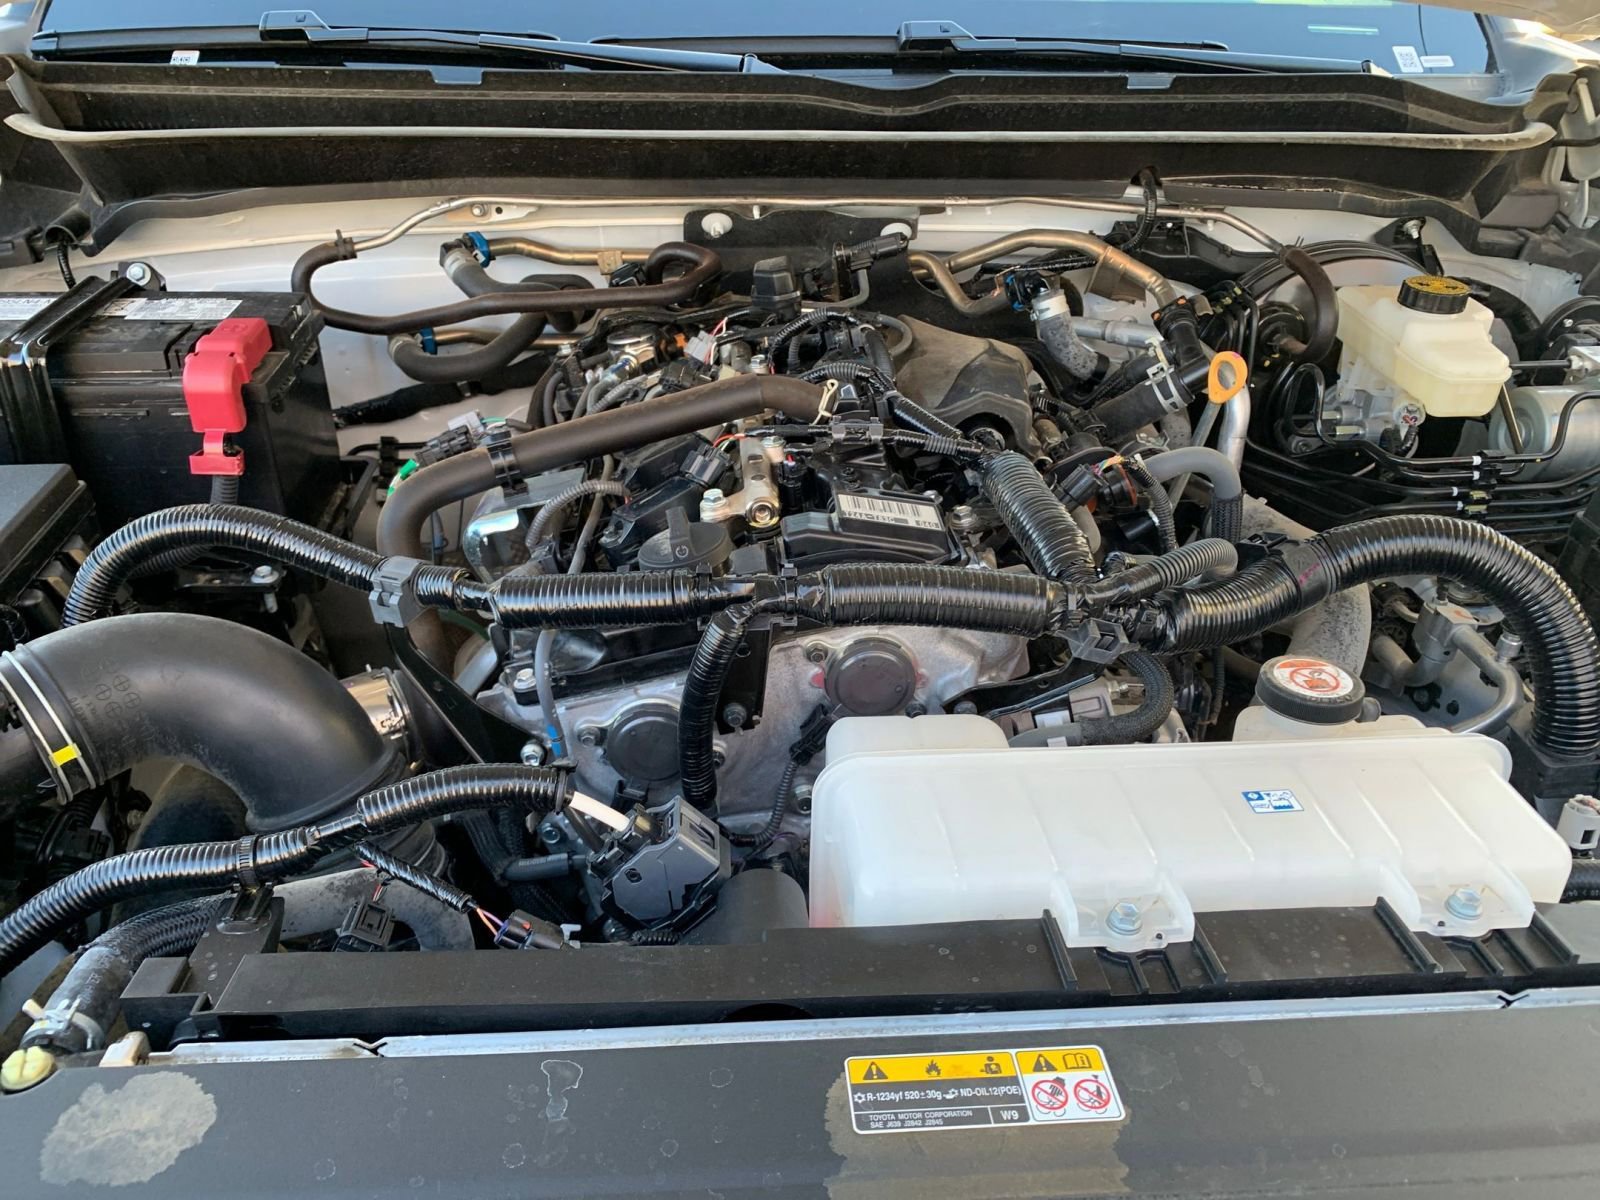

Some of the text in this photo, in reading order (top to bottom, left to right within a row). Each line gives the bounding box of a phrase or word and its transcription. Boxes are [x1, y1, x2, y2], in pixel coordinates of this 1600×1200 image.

[866, 1089, 942, 1103] R-1234yf 520±30g
[959, 1085, 1022, 1097] ND-OIL12(POE)
[869, 1110, 973, 1121] TOYOTA MOTOR CORPORATION
[1000, 1110, 1019, 1120] W9
